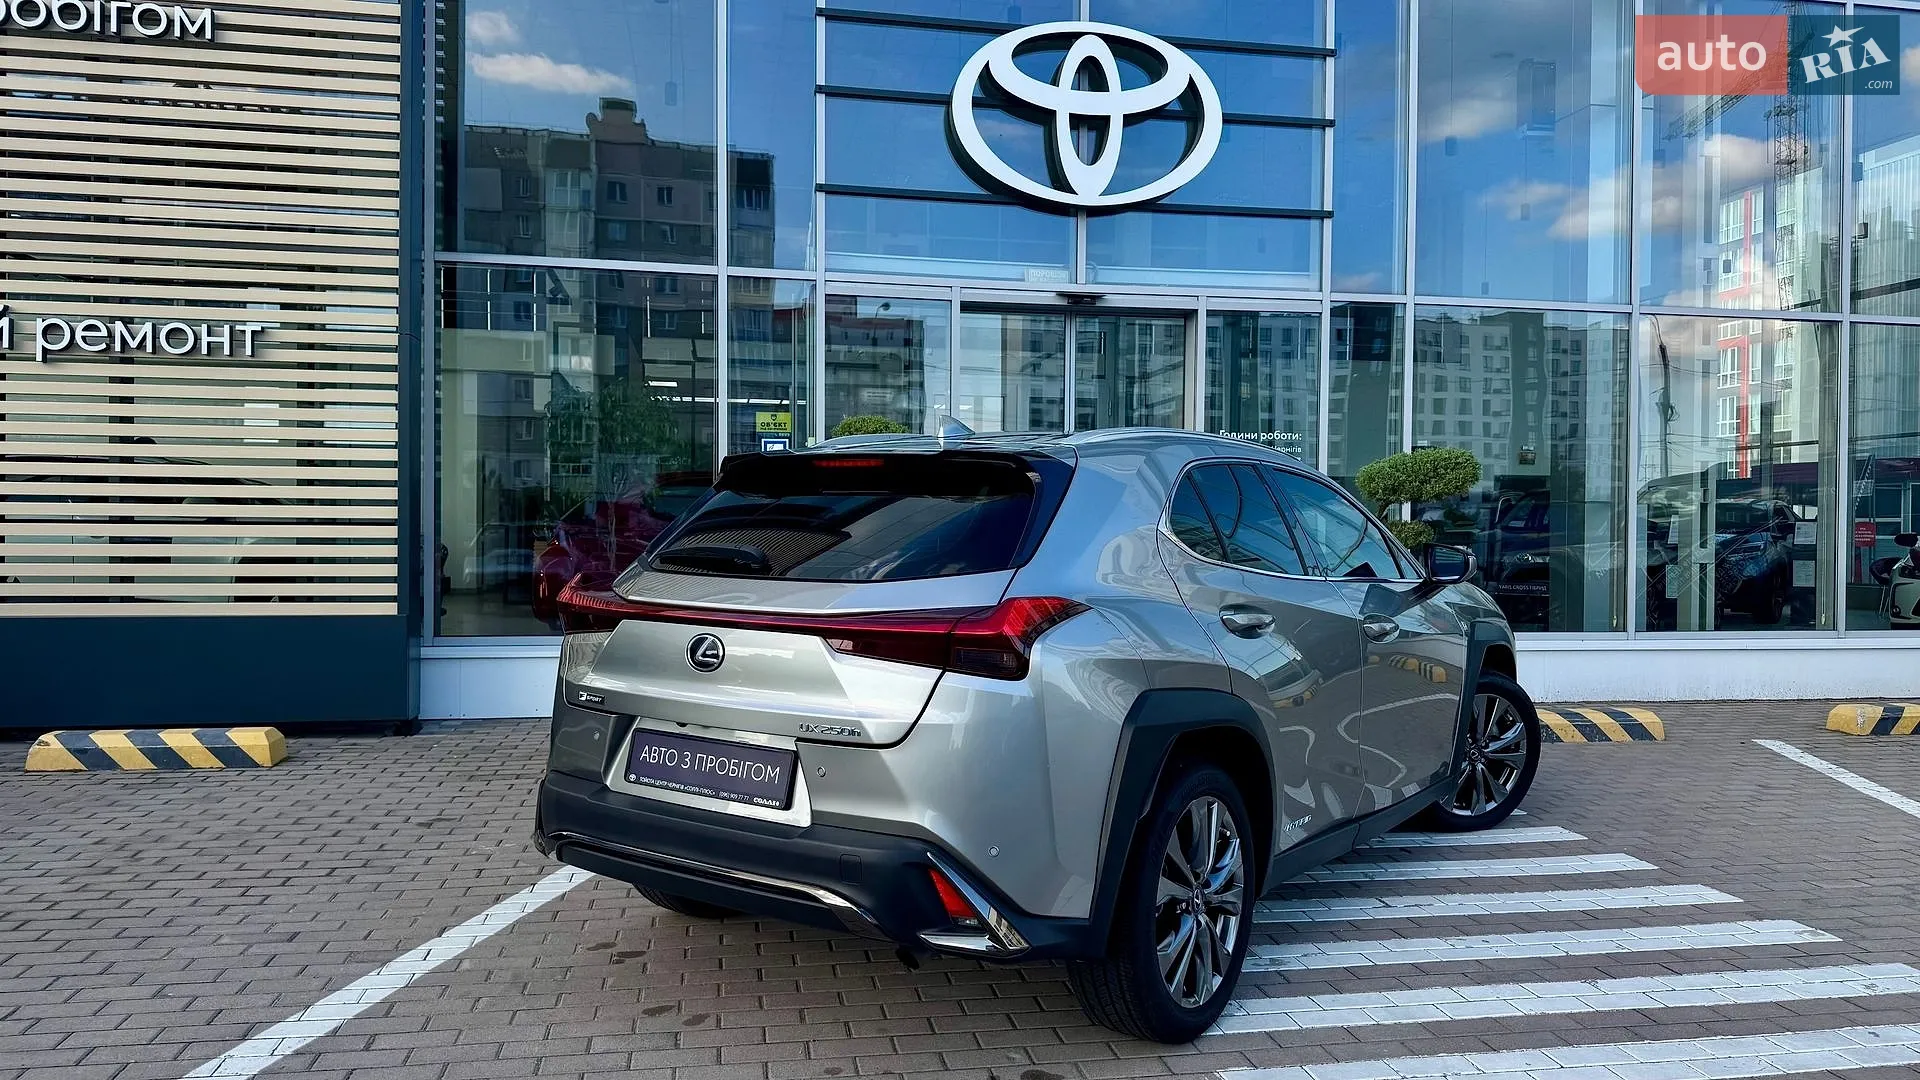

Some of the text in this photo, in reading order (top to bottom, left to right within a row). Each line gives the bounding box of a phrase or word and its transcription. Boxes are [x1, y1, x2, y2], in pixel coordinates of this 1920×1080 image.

[35, 317, 262, 362] ремонт
[1219, 429, 1302, 442] Години роботи:
[799, 722, 862, 737] UX 250h
[639, 744, 678, 767] АВТО
[694, 753, 780, 784] ПРОБІГОМ
